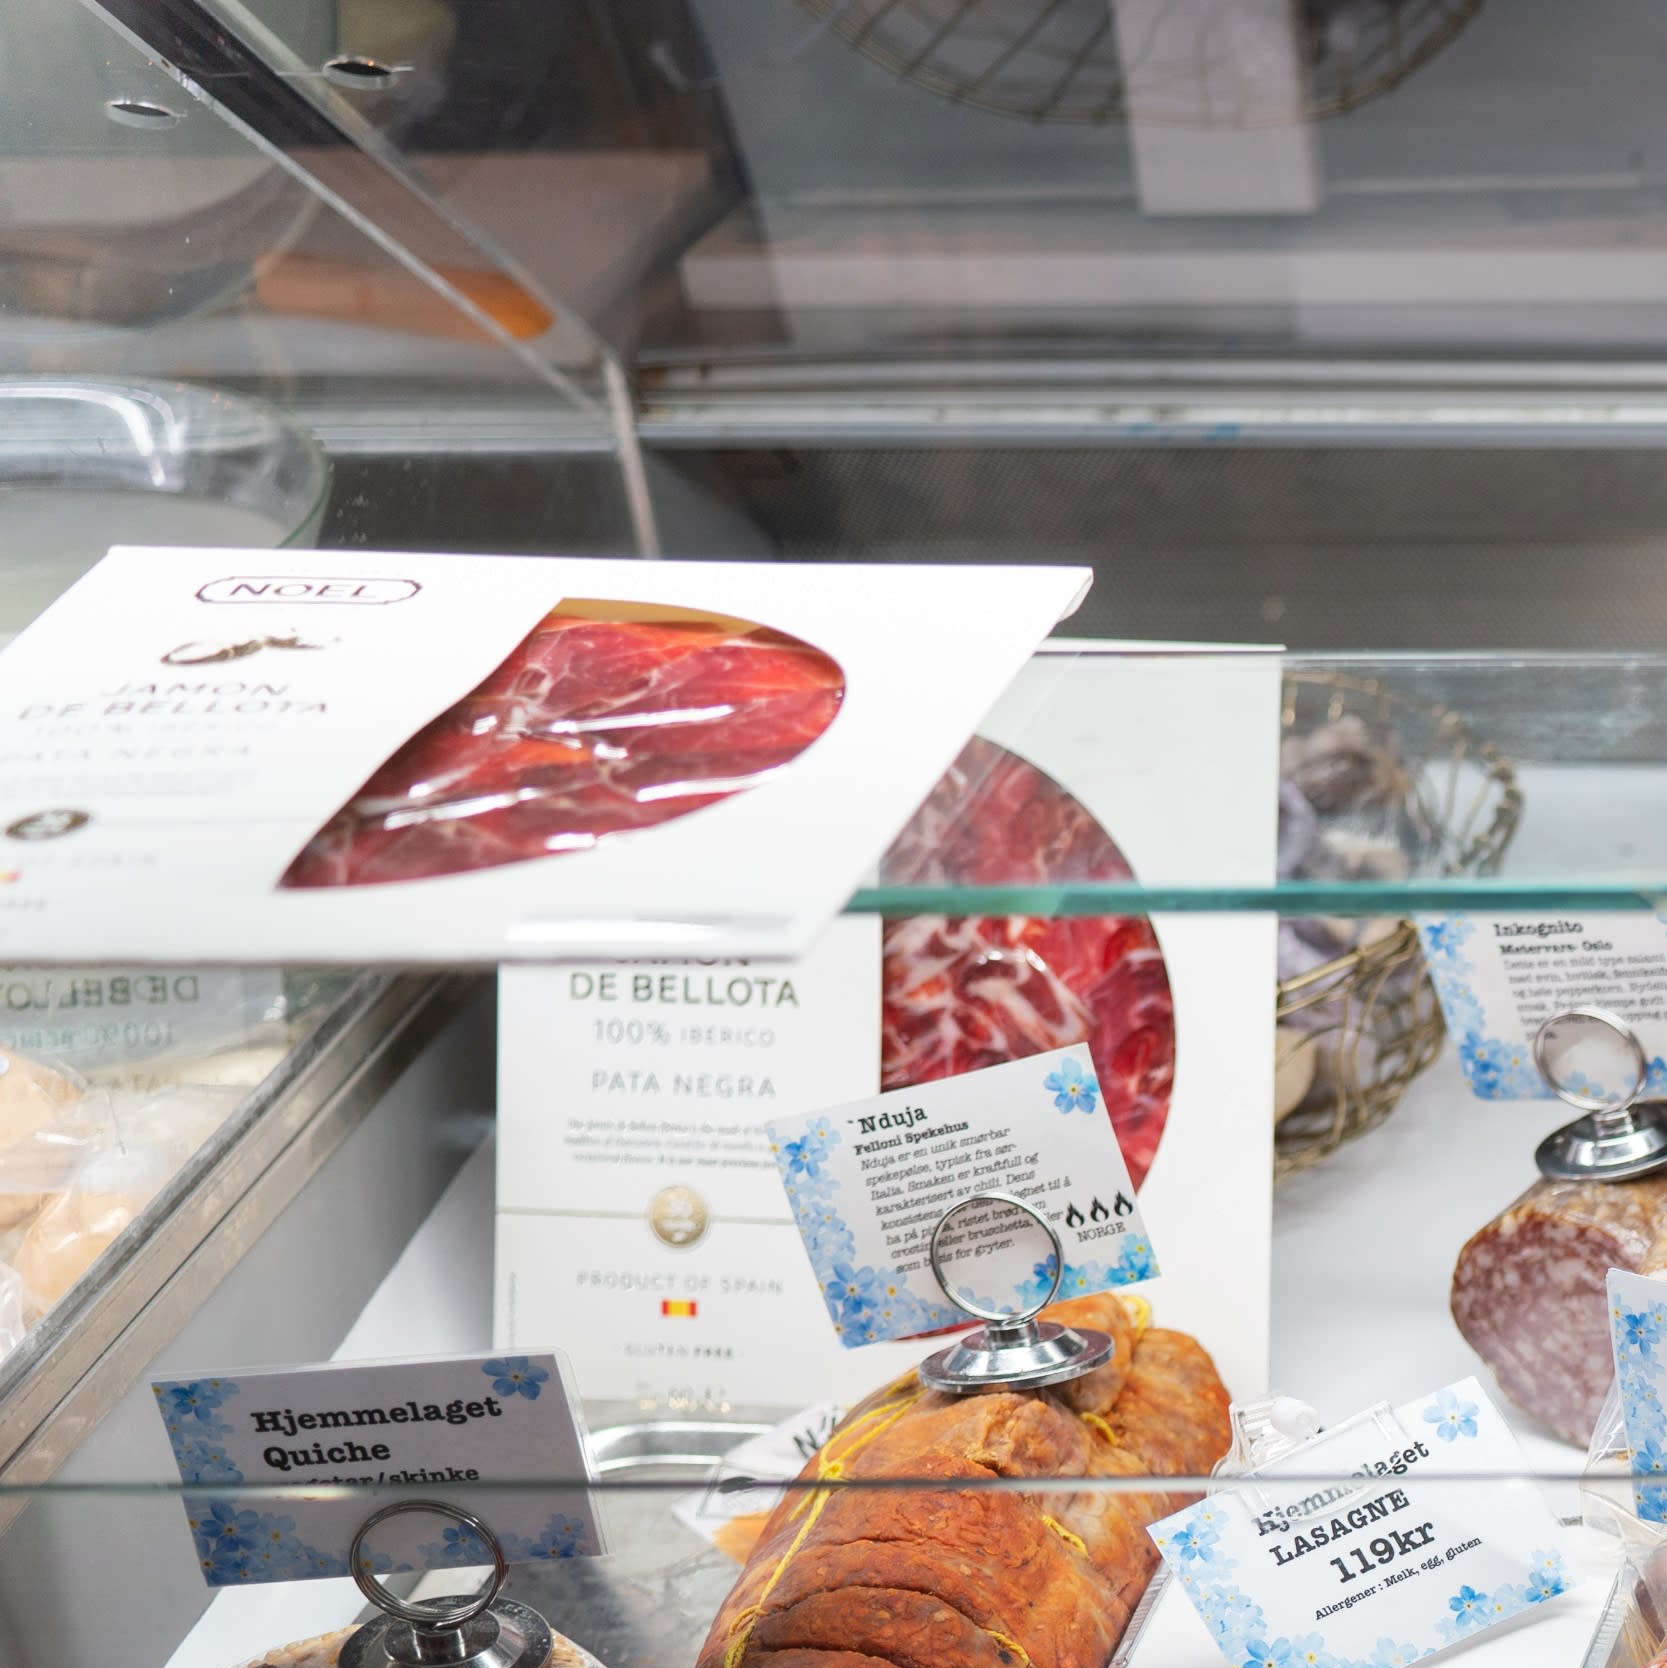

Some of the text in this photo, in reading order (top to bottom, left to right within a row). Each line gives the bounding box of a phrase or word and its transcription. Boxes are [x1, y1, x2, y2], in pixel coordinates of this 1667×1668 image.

[229, 583, 379, 599] NOEL
[1494, 920, 1584, 937] Inkognito
[570, 972, 800, 1008] DE BELLOTA
[592, 1069, 776, 1098] PATA NEGRA
[854, 1122, 969, 1155] Felloni Spekehus
[861, 1139, 956, 1170] Nduja unik
[935, 1150, 972, 1170] typisk
[908, 1156, 1039, 1192] Smaken kraftfull og
[876, 1172, 1035, 1216] karakterisert Dens
[958, 1205, 1018, 1228] ristet brød
[1077, 1221, 1126, 1243] NORGE
[896, 1241, 1015, 1272] som for gryter.
[576, 1270, 783, 1295] PRODUCT OF SPAIN
[251, 1396, 502, 1436] Hjemmelaget
[263, 1441, 391, 1471] Quiche
[1268, 1487, 1411, 1566] LASAGNE
[1330, 1520, 1435, 1584] 119kr
[1314, 1536, 1483, 1621] Allergener Melk, egg, gluten
